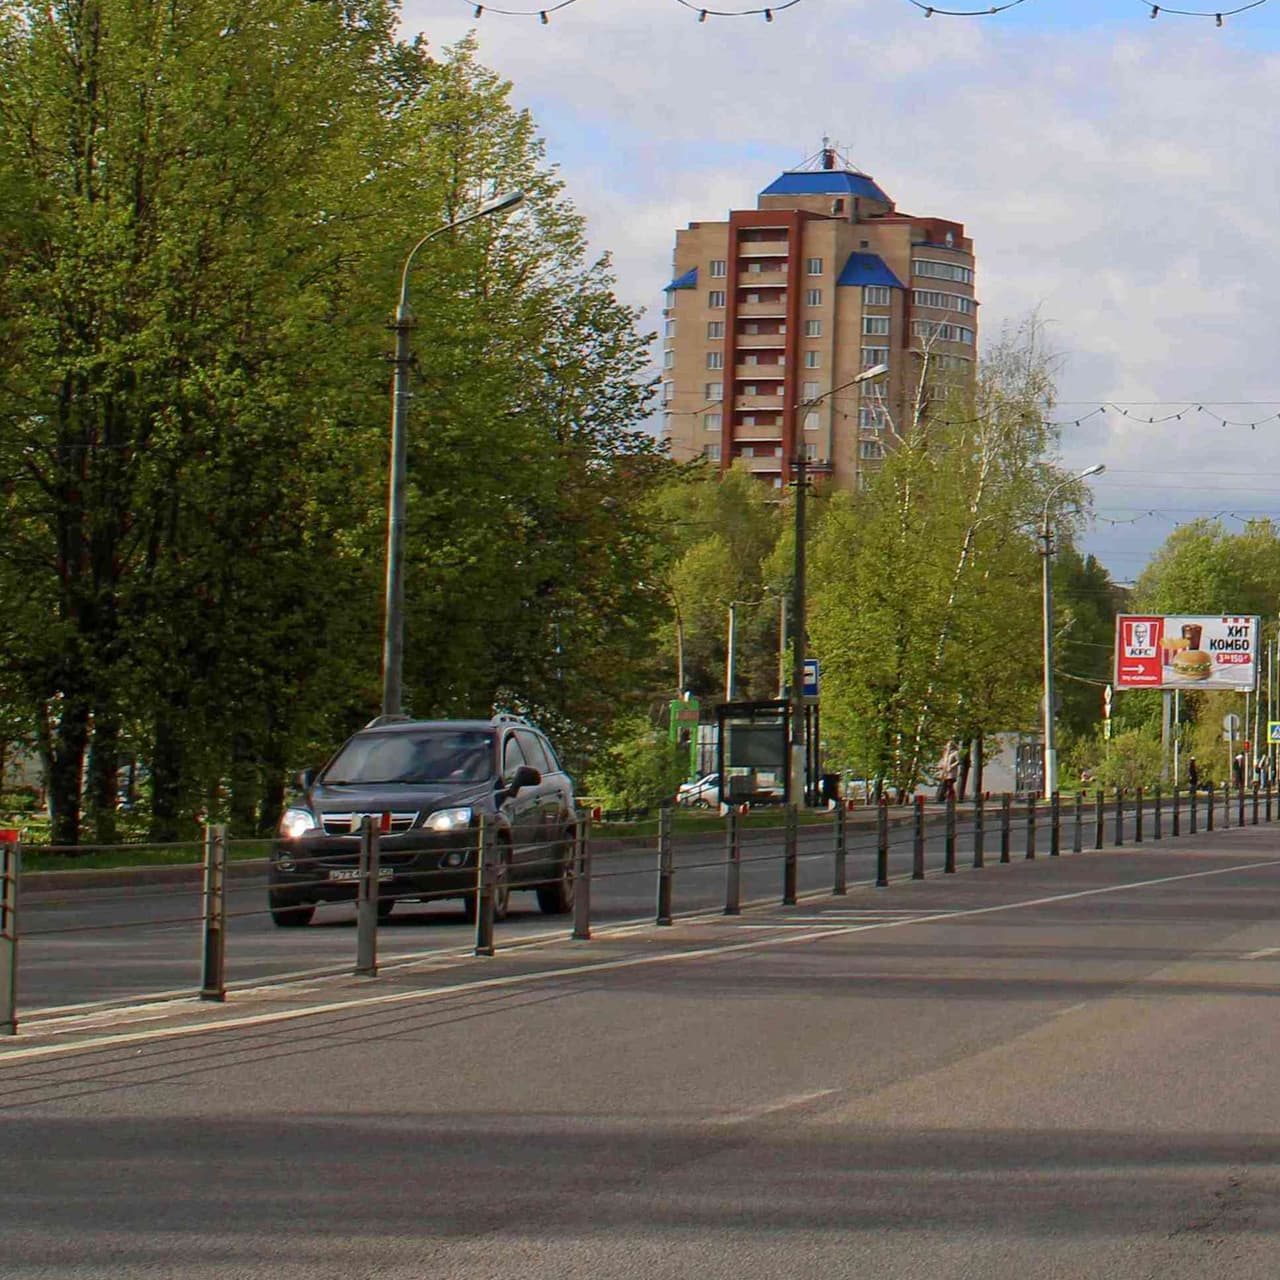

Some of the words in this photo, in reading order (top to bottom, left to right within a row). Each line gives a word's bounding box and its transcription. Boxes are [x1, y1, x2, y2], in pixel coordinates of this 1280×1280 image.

[1227, 626, 1250, 637] ХИТ
[1209, 639, 1250, 651] КОМБО
[1130, 648, 1152, 656] KFC
